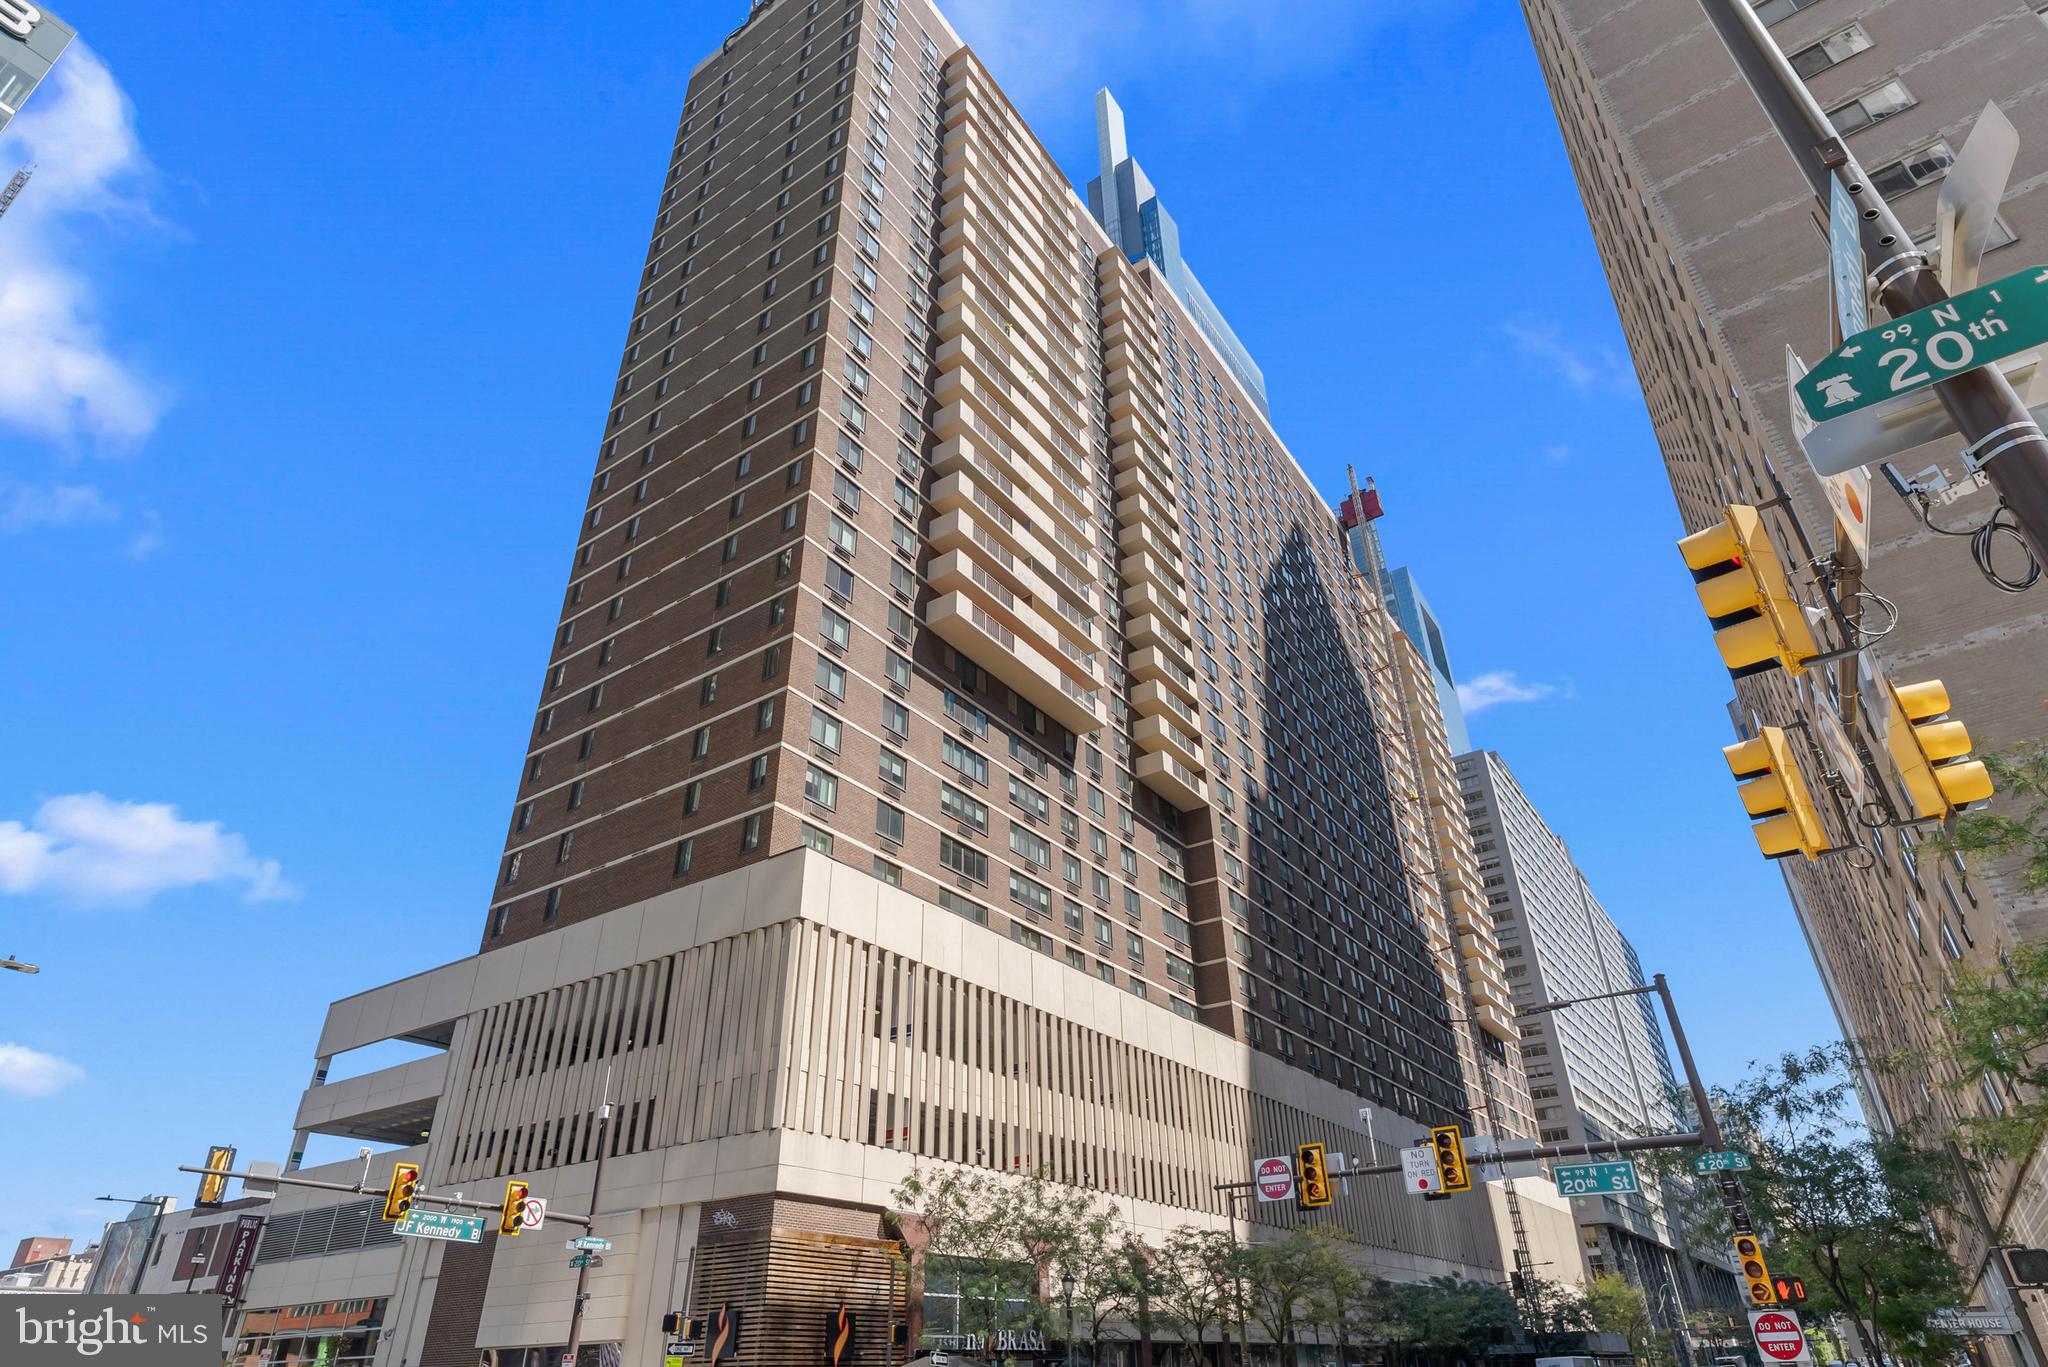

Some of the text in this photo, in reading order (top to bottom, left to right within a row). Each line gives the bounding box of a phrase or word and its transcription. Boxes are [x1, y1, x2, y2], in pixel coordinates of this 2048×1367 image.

[1881, 290, 2002, 342] 99 N 1
[1878, 318, 2009, 391] 20th
[1410, 1150, 1425, 1159] NO
[1410, 1160, 1430, 1169] TURN
[1708, 1157, 1748, 1170] 20th St
[1261, 1165, 1286, 1175] DO NOT
[1407, 1169, 1435, 1178] ON RED
[1588, 1167, 1597, 1177] N
[1604, 1167, 1608, 1175] 1
[1265, 1183, 1287, 1193] ENTER
[1562, 1175, 1631, 1193] 20th St
[422, 1214, 438, 1222] 2000
[440, 1216, 448, 1224] W
[397, 1221, 415, 1232] JF
[416, 1222, 461, 1239] Kennedy
[583, 1240, 604, 1250] Kennedy
[225, 1230, 250, 1293] PARKING
[1758, 1321, 1792, 1331] DO NOT
[1968, 1318, 2002, 1328] HOUSE
[996, 1329, 1047, 1351] BRASA
[1767, 1342, 1796, 1352] ENTER
